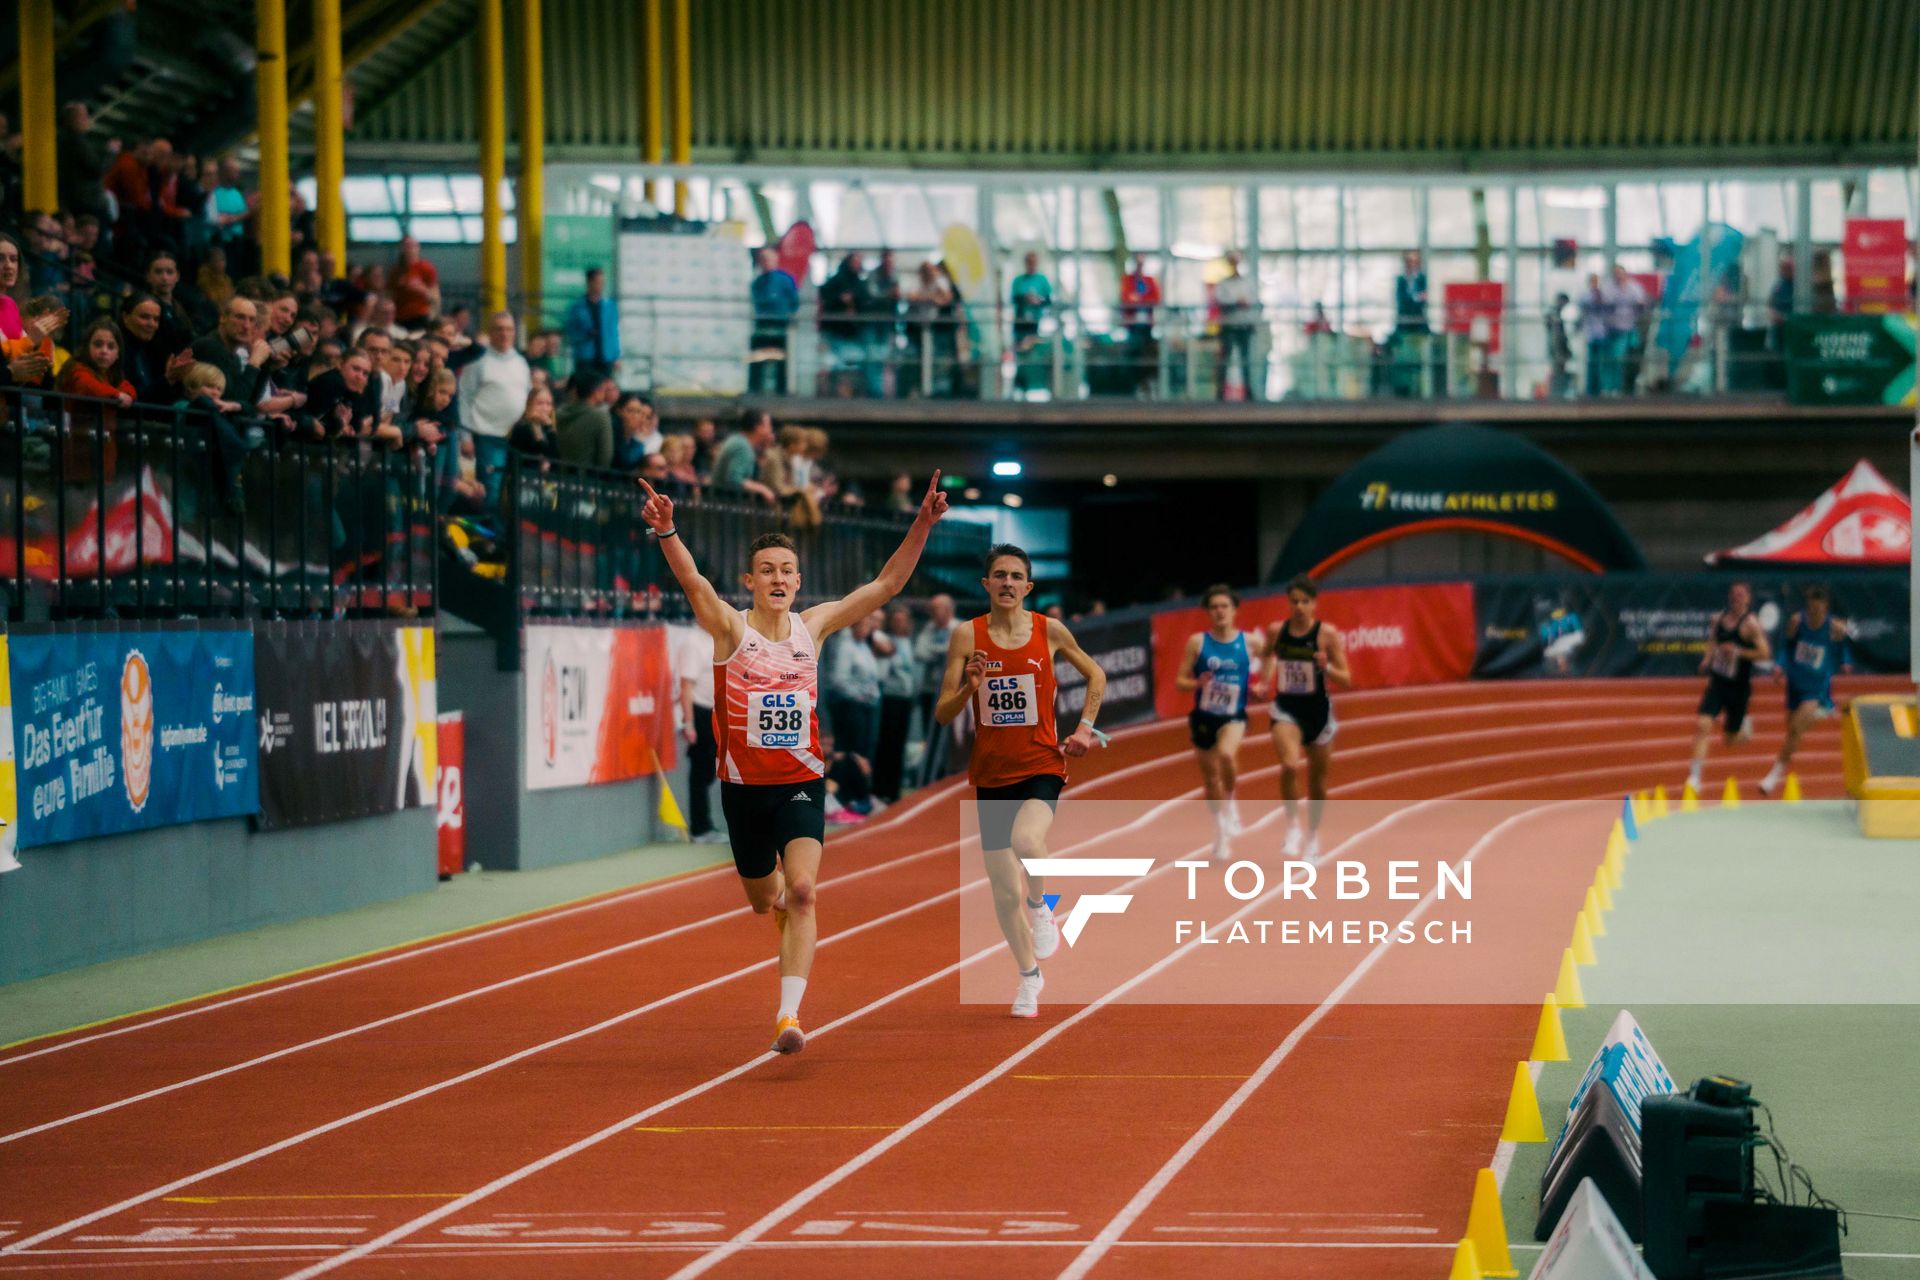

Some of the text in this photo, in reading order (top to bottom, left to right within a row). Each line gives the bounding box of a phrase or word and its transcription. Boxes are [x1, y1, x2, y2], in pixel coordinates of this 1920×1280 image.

[988, 691, 1027, 711] 486
[758, 709, 803, 731] 538
[24, 723, 50, 770] Das
[33, 775, 66, 820] eure
